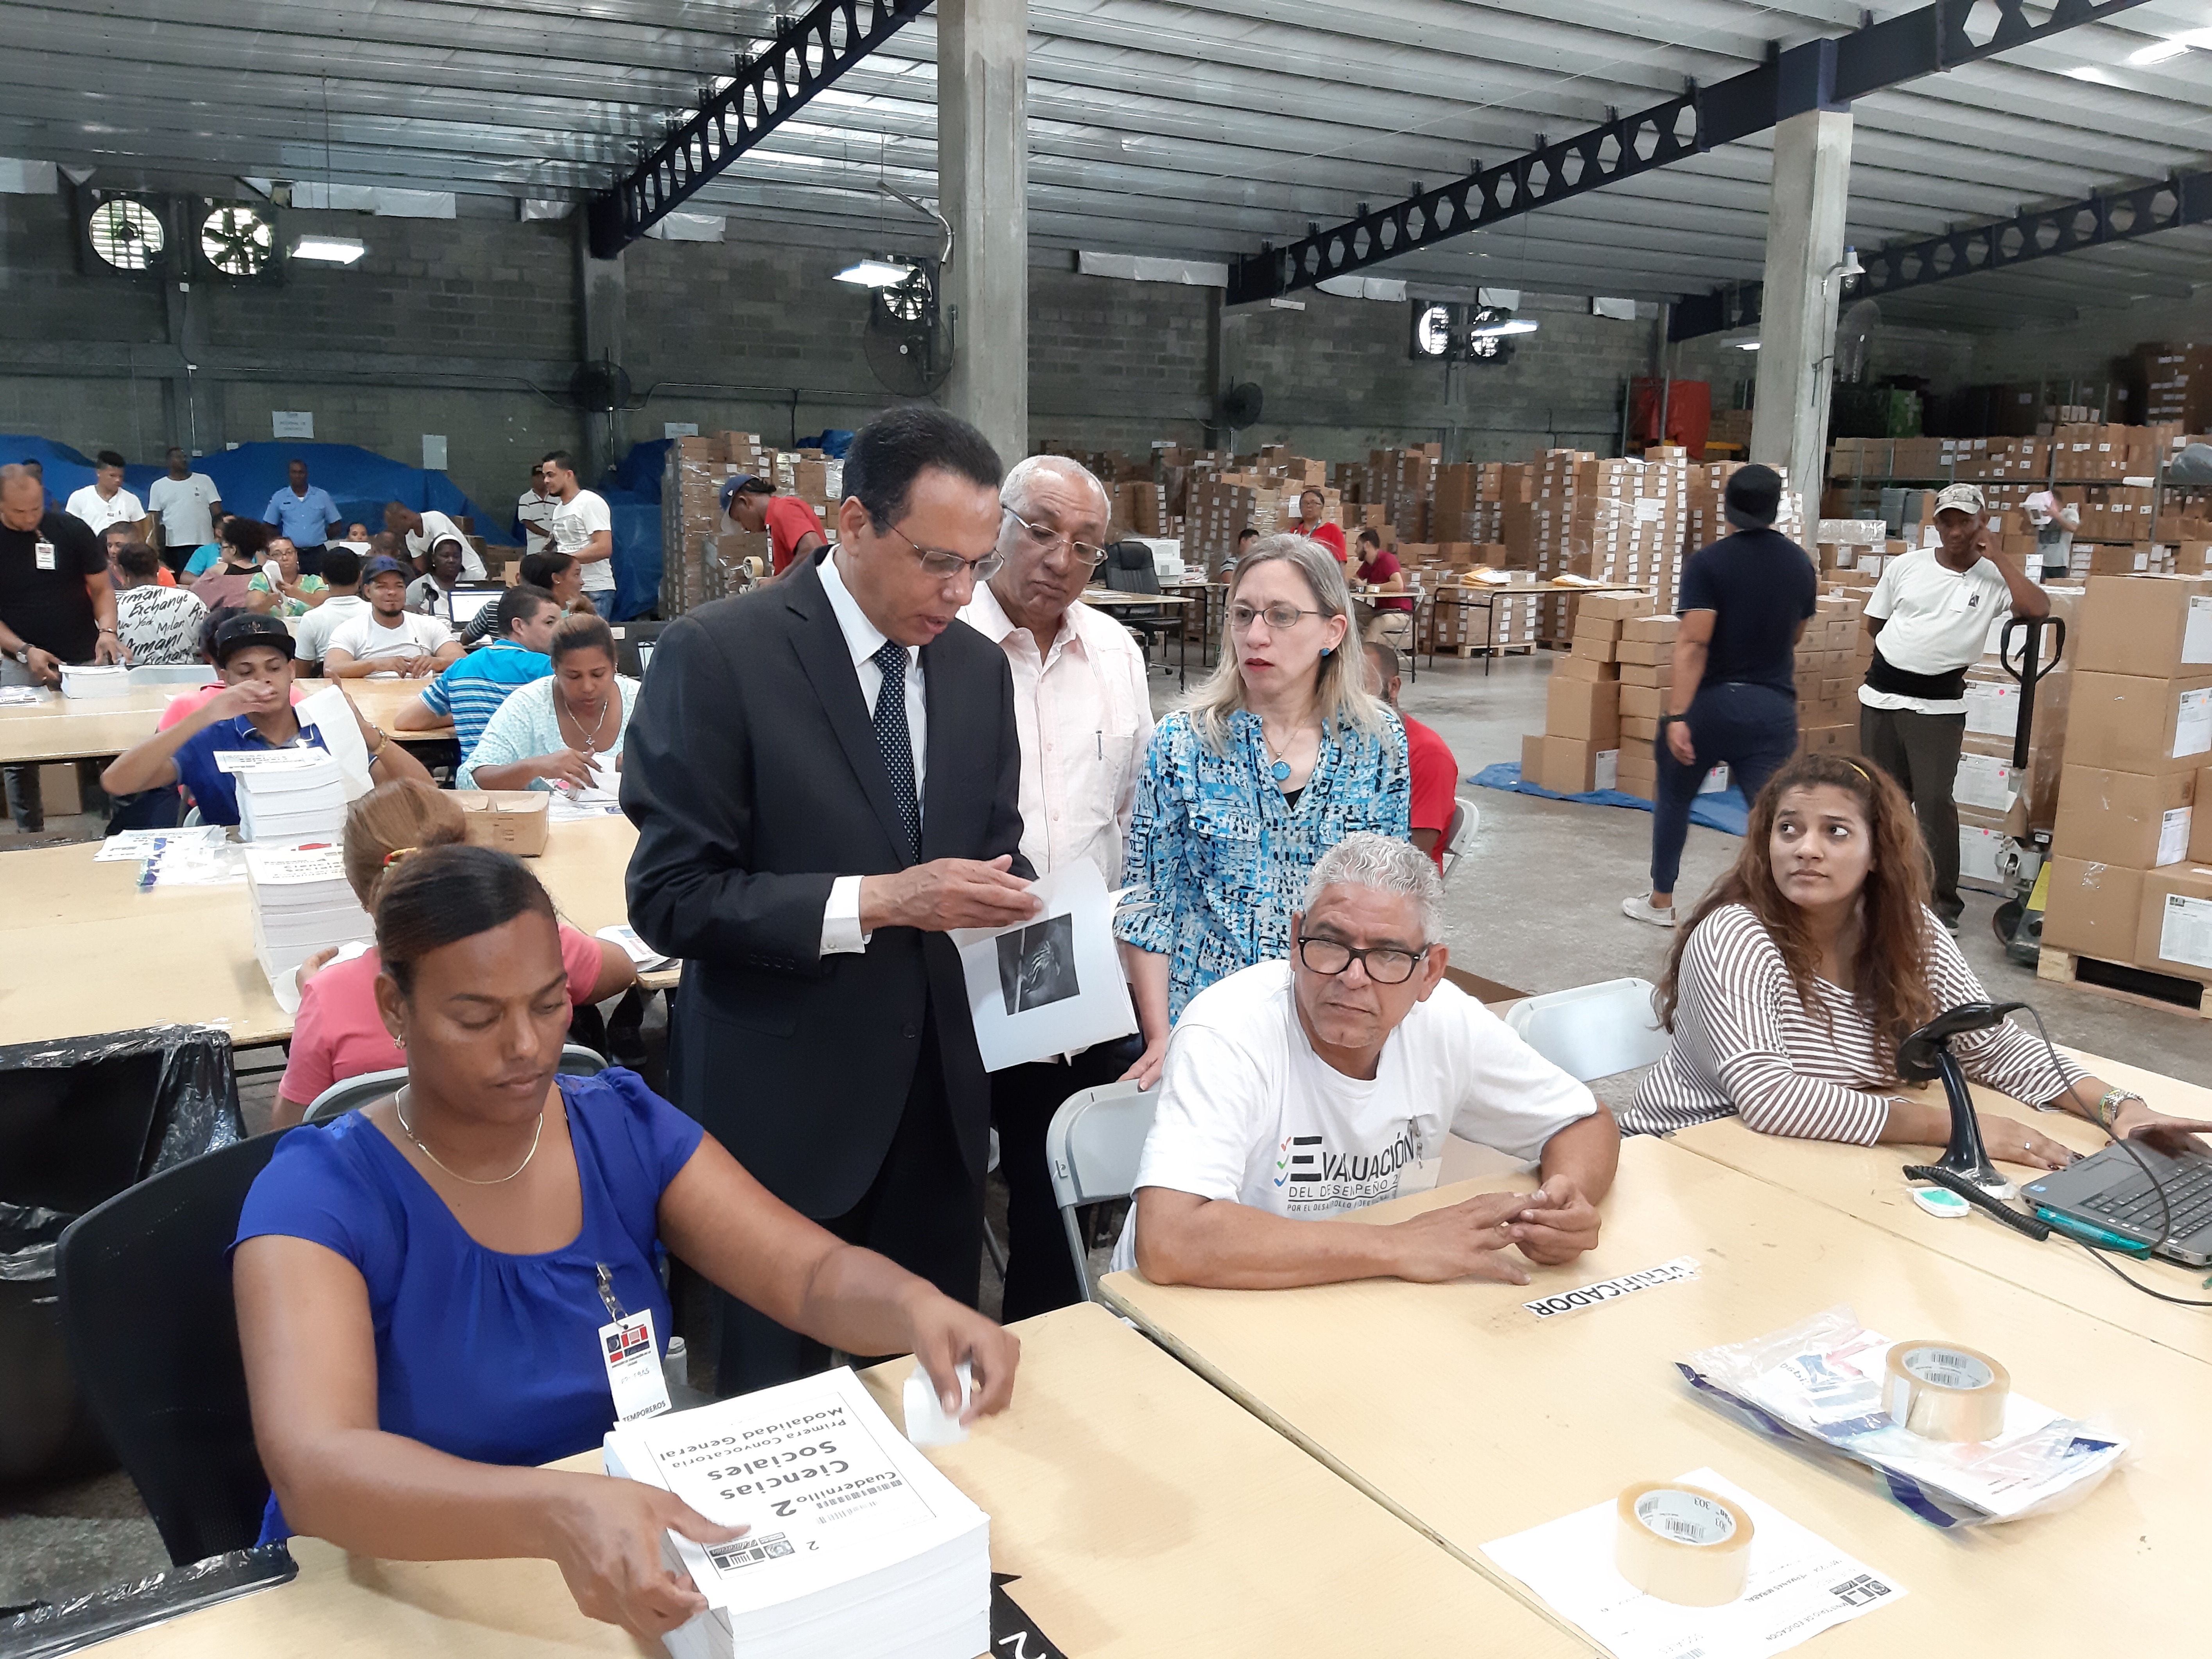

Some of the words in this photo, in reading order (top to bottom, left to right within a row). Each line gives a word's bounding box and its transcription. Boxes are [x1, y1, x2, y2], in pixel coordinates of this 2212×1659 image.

[1289, 1186, 1313, 1198] DEL
[742, 1407, 843, 1440] Modalidad
[786, 1419, 847, 1439] Primera
[660, 1437, 736, 1461] General
[672, 1437, 782, 1468] Convocatoria
[707, 1440, 837, 1481] Sociales
[720, 1460, 849, 1499] Ciencias
[796, 1471, 897, 1503] Cuadernillo
[770, 1499, 797, 1517] 2
[1694, 1498, 1711, 1510] 303
[806, 1540, 820, 1551] 2
[1765, 1620, 1805, 1641] EDUCACION
